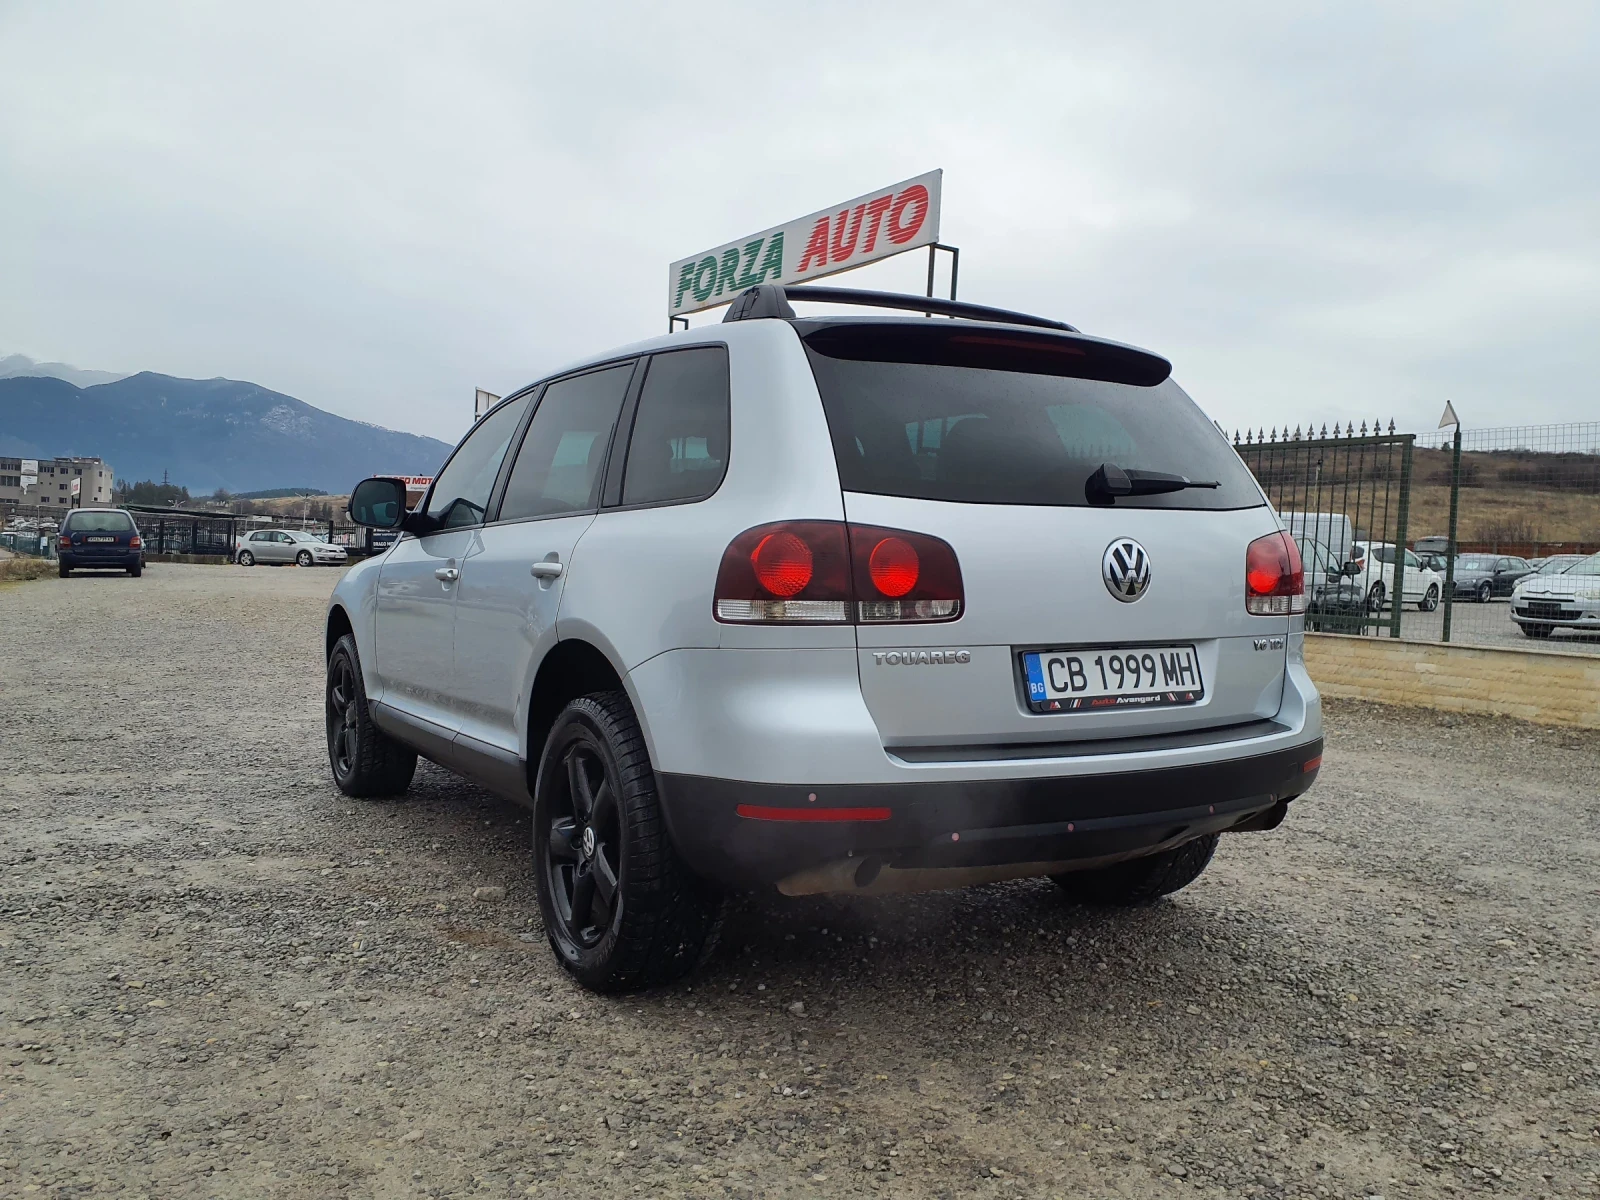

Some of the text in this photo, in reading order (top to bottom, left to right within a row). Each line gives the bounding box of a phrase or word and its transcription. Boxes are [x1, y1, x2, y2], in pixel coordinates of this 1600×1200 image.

[673, 184, 929, 308] FORZA AUTO
[872, 650, 971, 666] TOUAREG
[1048, 652, 1196, 693] CB 1999 MH
[1030, 682, 1045, 694] BG
